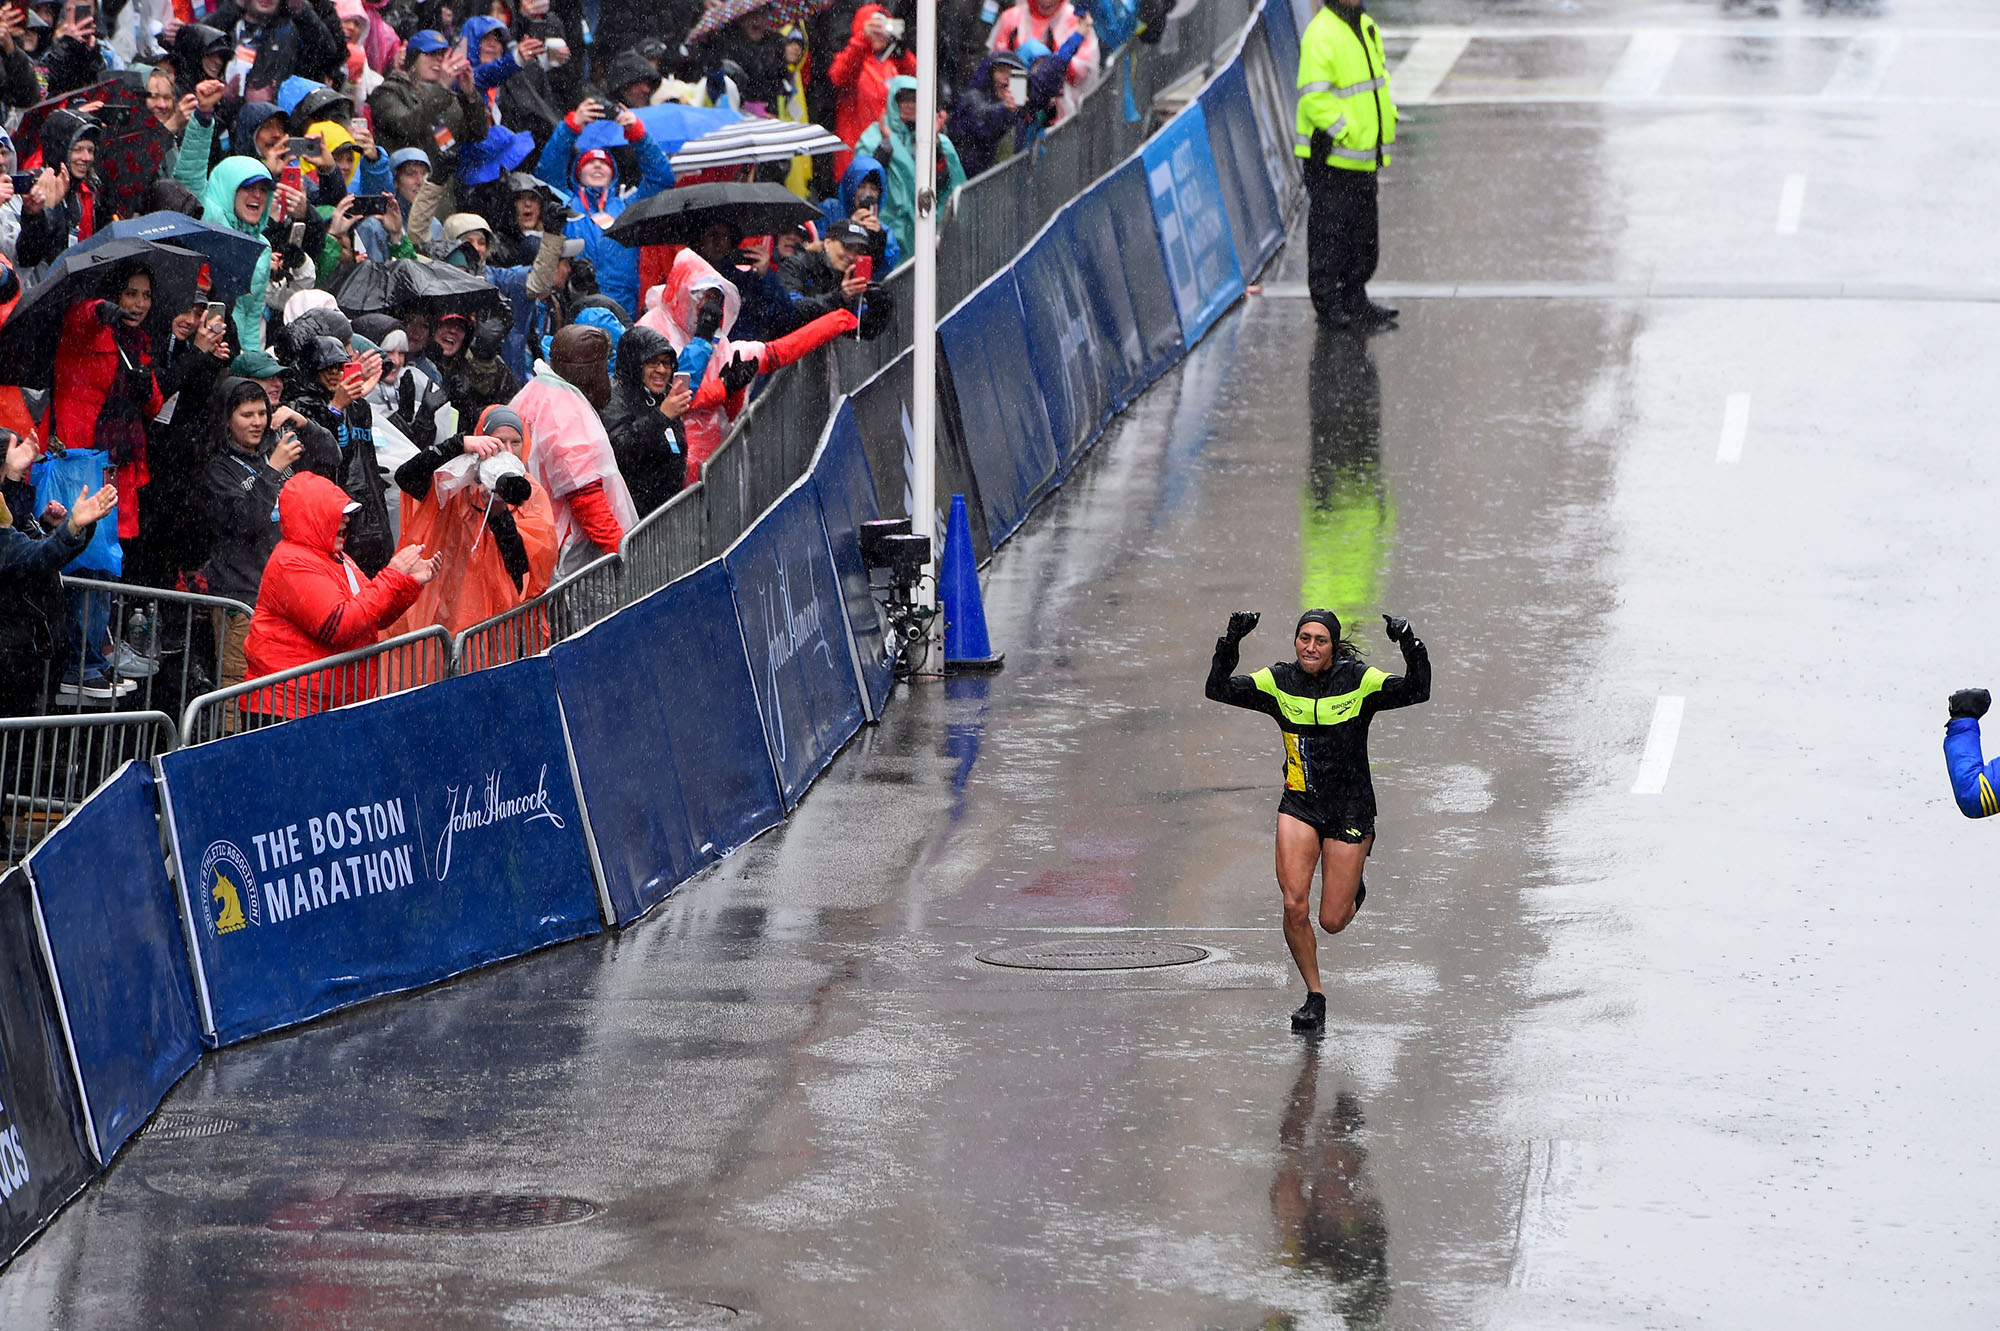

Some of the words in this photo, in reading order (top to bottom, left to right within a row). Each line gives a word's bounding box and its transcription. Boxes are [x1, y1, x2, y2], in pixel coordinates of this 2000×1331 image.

[481, 763, 566, 829] Hancock
[252, 823, 303, 873] THE
[308, 797, 406, 855] BOSTON
[202, 844, 227, 881] ATHLETIC
[227, 846, 259, 918] ASSOCIATION
[264, 844, 414, 924] MARATHON
